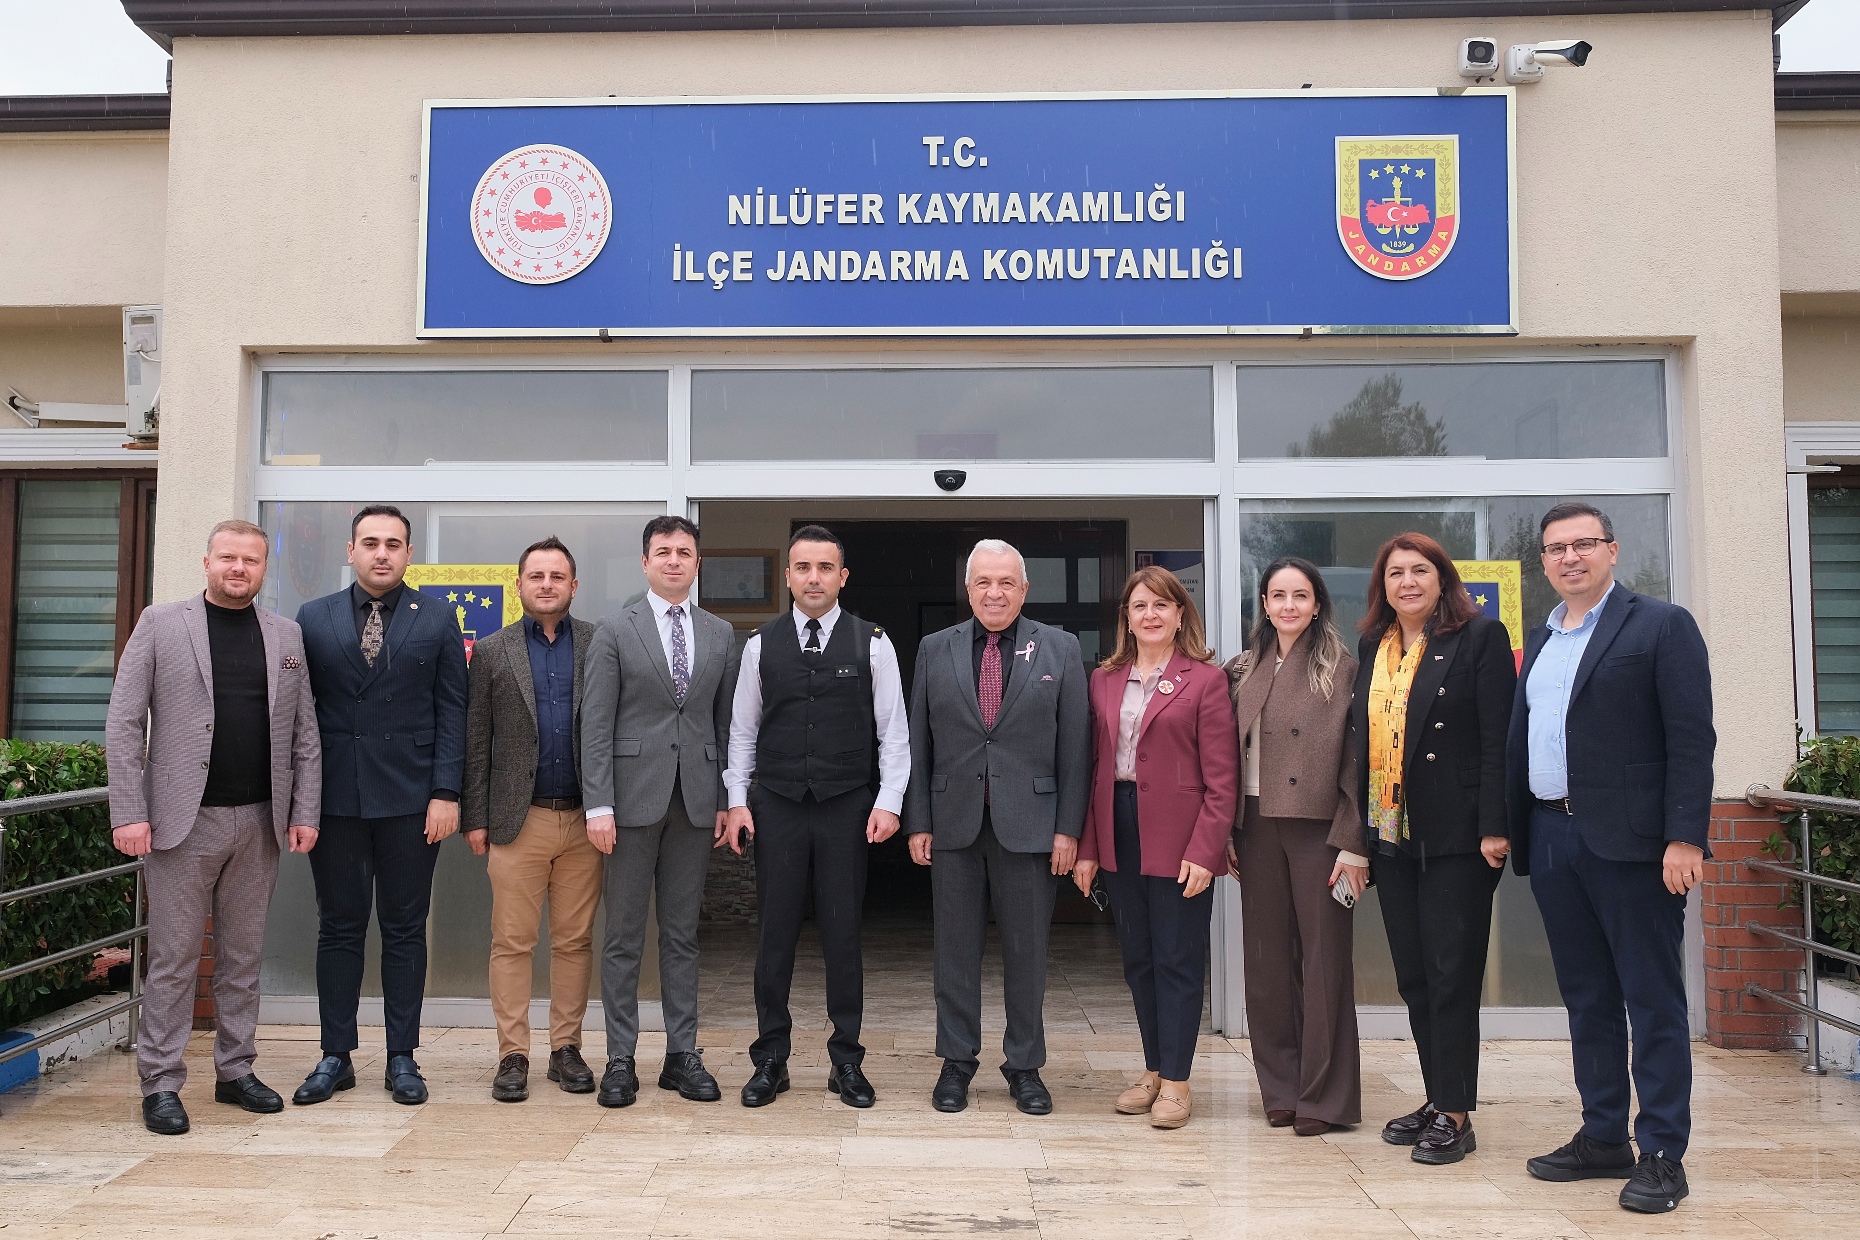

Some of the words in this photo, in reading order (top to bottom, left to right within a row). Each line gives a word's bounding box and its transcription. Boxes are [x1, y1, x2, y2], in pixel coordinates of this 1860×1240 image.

[922, 136, 989, 168] T.C.
[500, 173, 549, 214] CUMHURİYETİ
[551, 173, 583, 204] İÇİŞLERİ
[728, 186, 884, 226] NİLÜFER
[898, 182, 1186, 224] KAYMAKAMLIĞI
[499, 216, 524, 251] TÜRKİYE
[555, 206, 583, 252] BAKANLIĞI
[1389, 240, 1407, 249] 1839
[672, 242, 753, 290] İLÇE
[766, 249, 970, 282] JANDARMA
[983, 239, 1243, 281] KOMUTANLIĞI
[1348, 230, 1449, 273] JANDARMA
